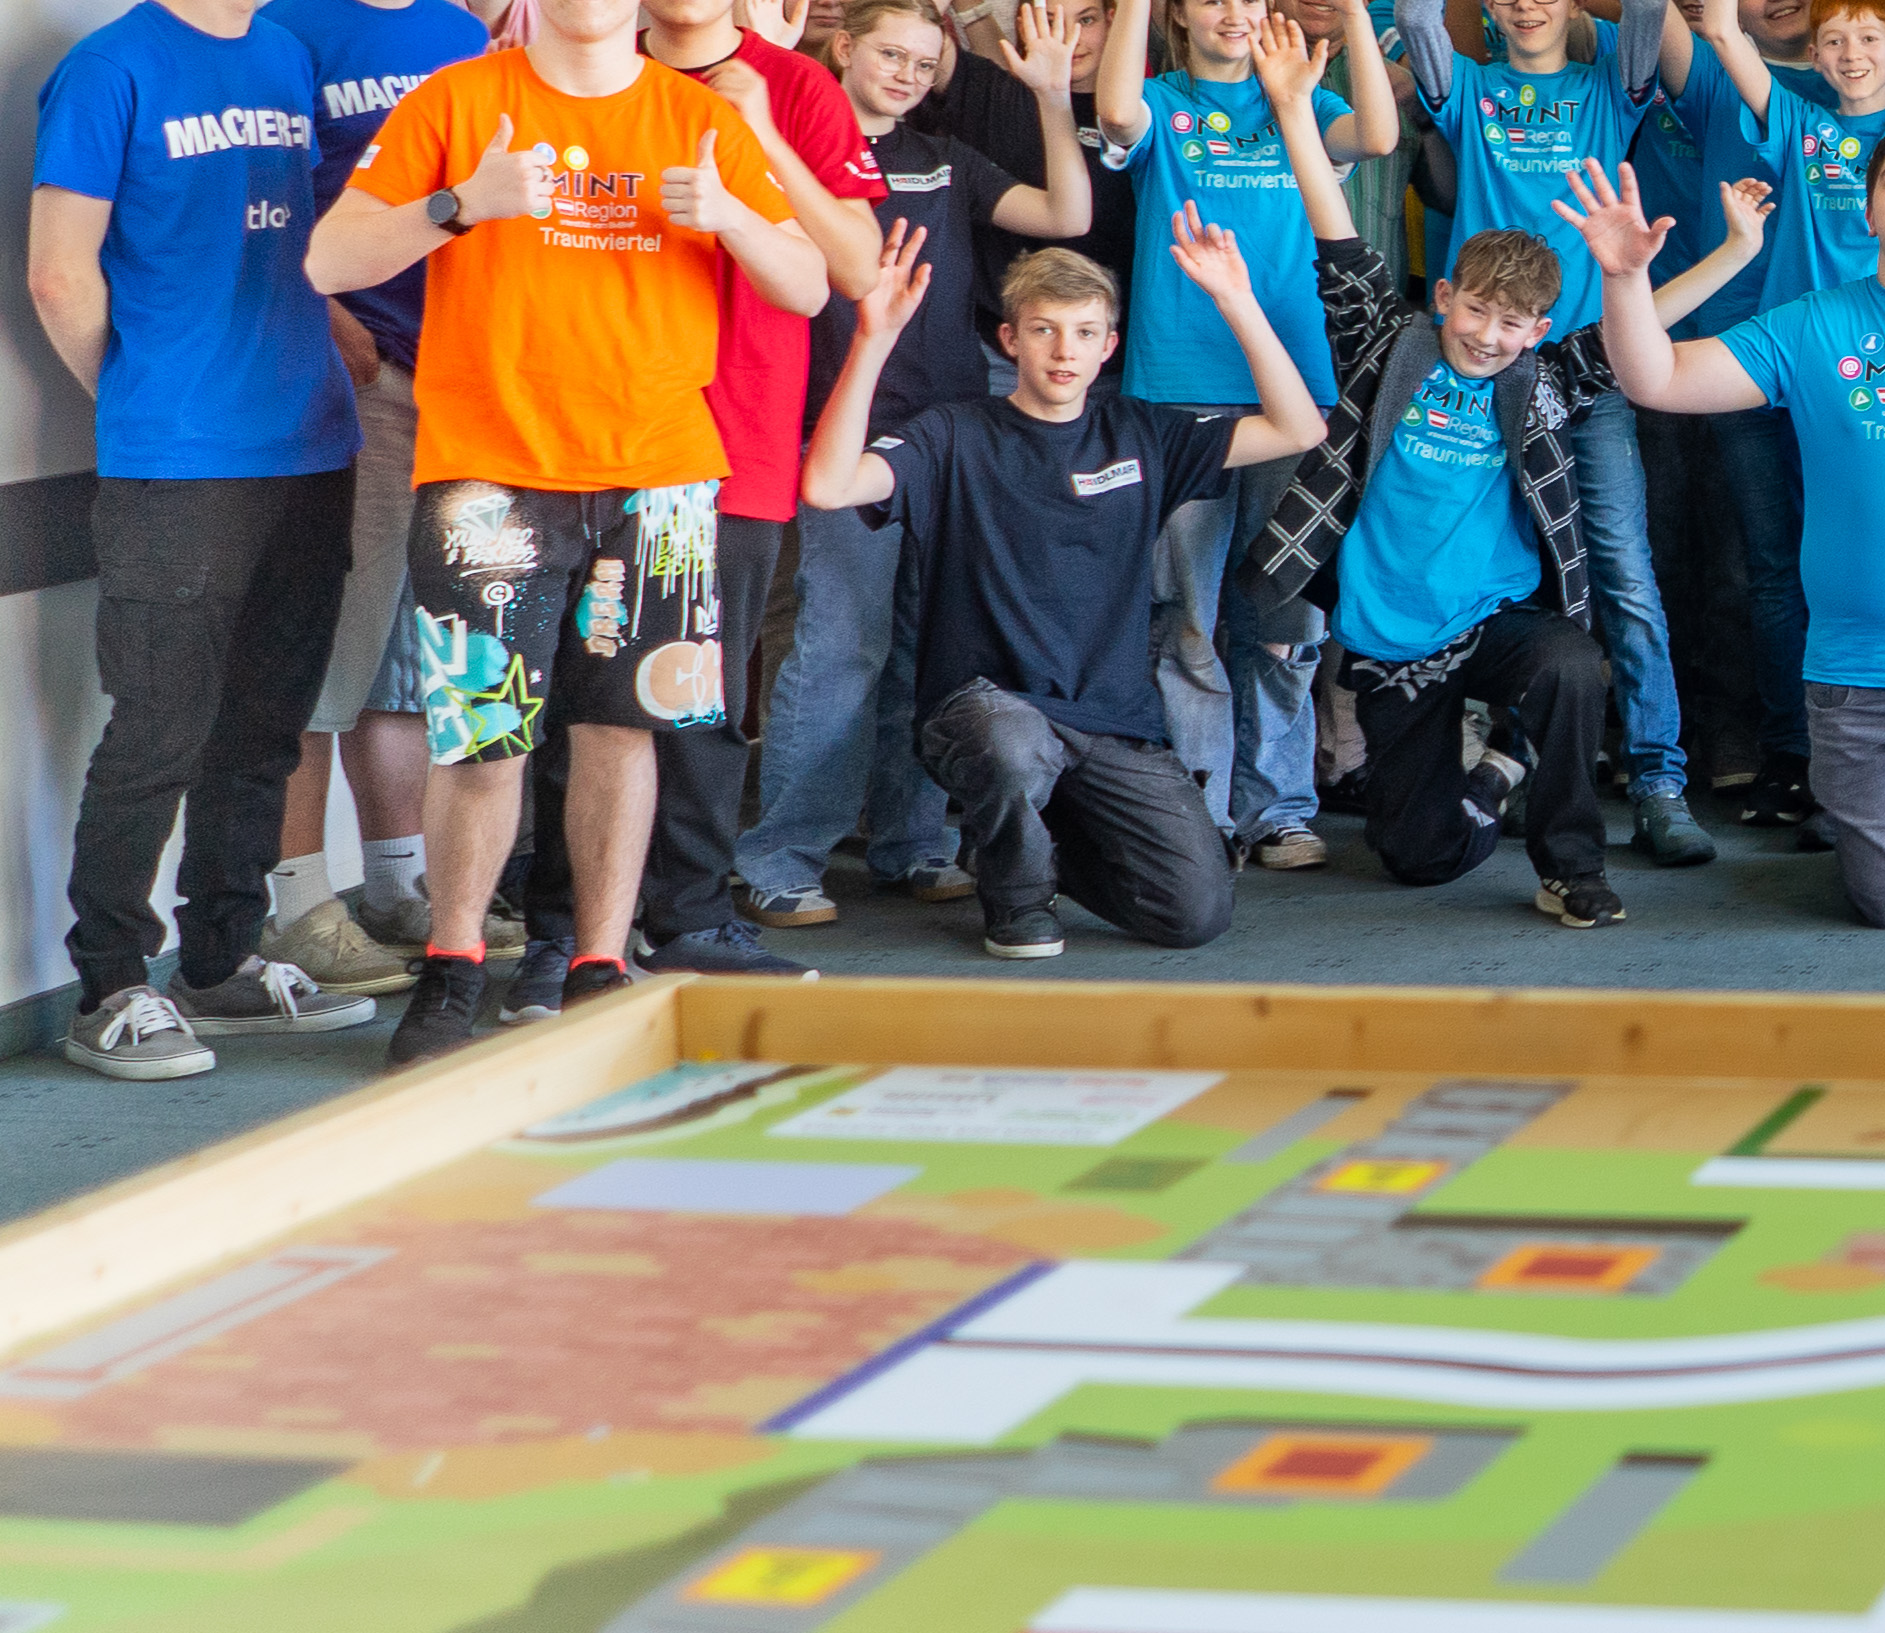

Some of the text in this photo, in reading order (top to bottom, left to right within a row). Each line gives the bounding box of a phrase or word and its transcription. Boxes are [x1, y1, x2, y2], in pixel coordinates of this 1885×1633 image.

[1497, 100, 1580, 124] MINT
[573, 200, 638, 222] Region
[539, 226, 662, 253] Traunviertel
[1421, 387, 1491, 422] MIN
